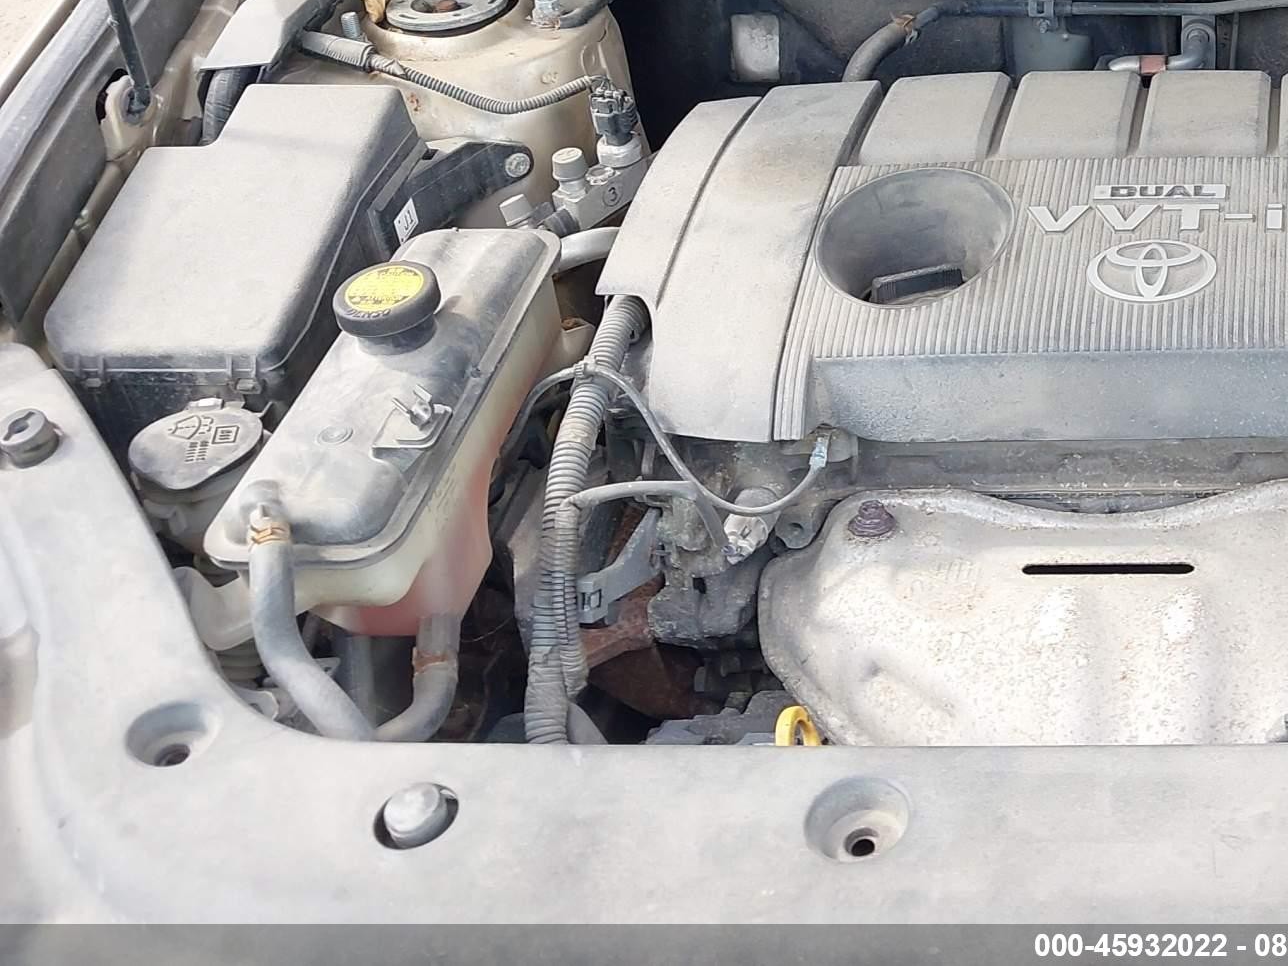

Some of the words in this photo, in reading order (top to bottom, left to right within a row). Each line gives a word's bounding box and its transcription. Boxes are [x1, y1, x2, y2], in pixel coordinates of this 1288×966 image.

[607, 187, 618, 202] 3
[1110, 185, 1216, 197] DUAL
[1027, 203, 1284, 234] VVT-i
